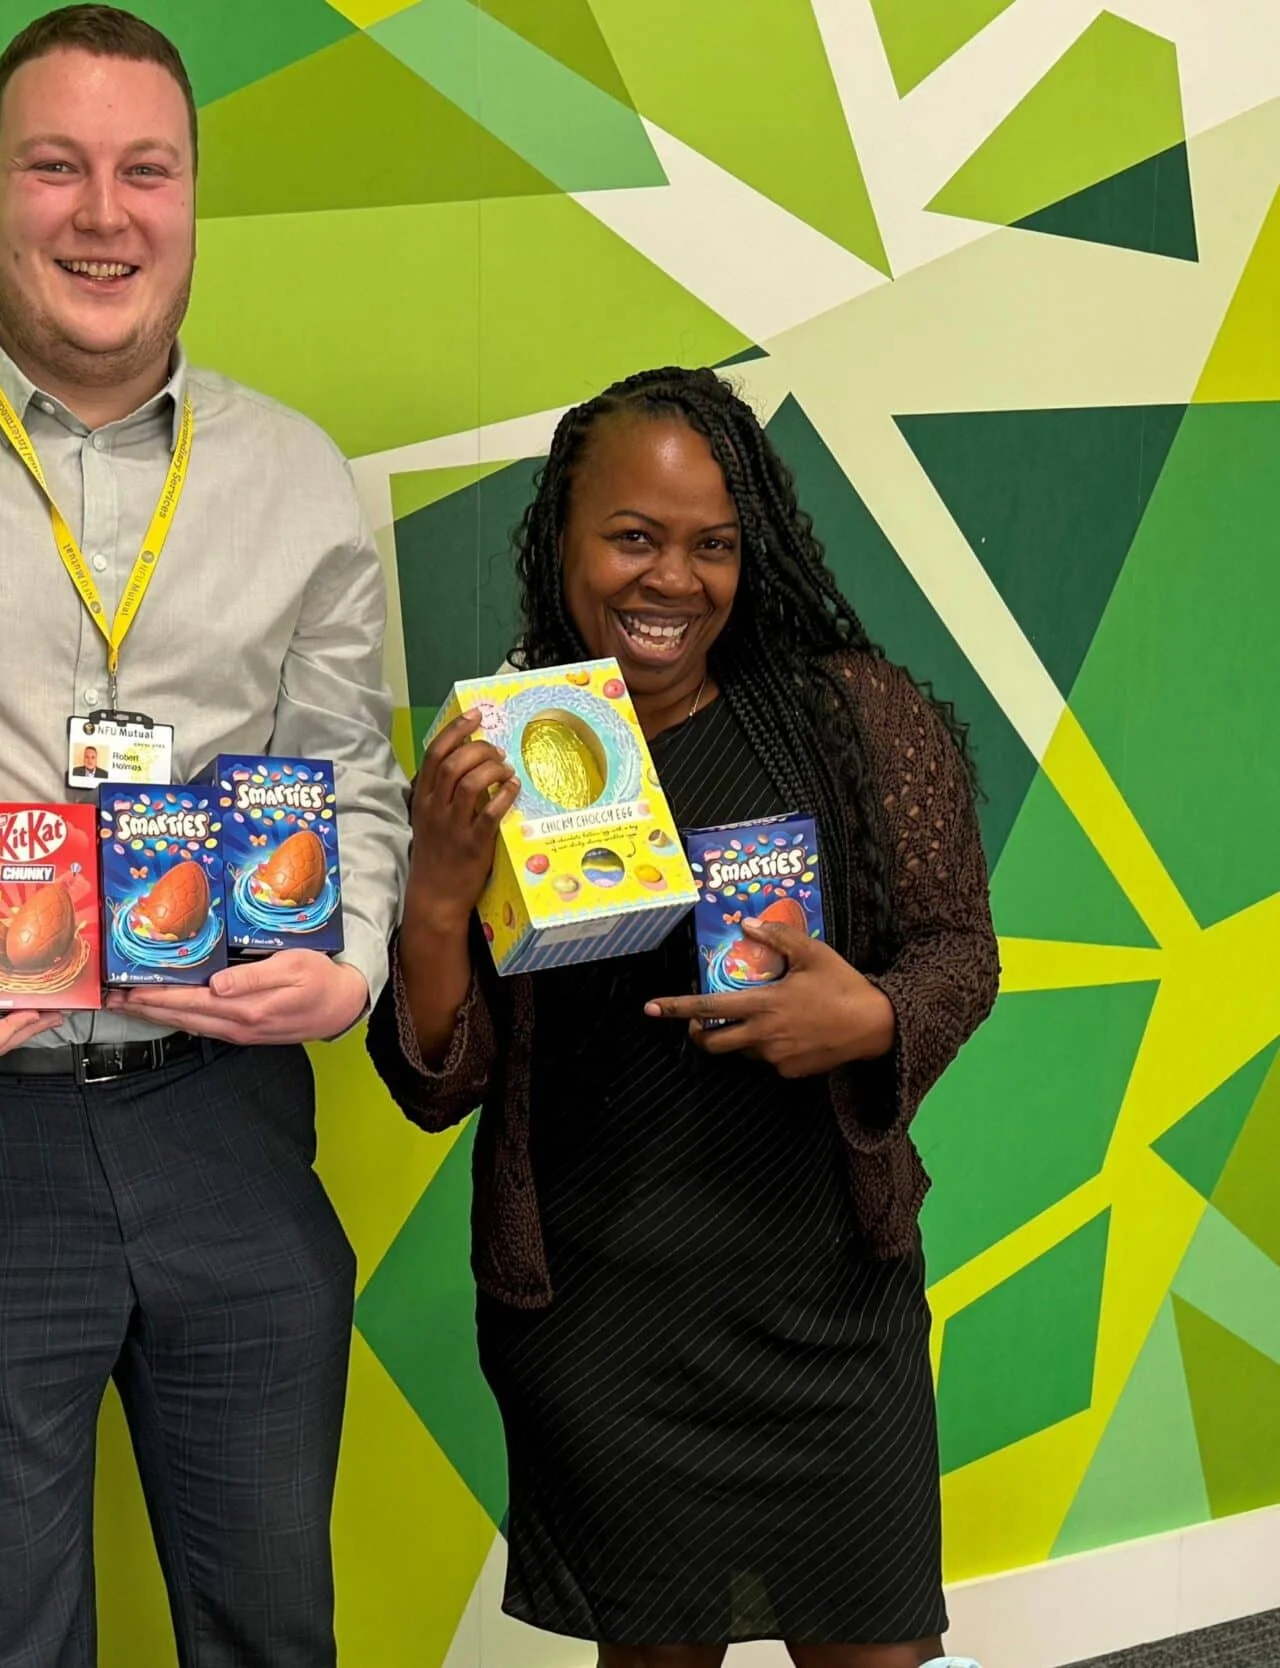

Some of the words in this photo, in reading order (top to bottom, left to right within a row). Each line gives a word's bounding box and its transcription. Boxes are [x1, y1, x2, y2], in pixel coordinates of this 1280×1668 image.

[159, 472, 182, 519] Services
[98, 726, 117, 736] NFU
[119, 728, 154, 739] Mutual
[112, 752, 139, 762] Robert
[112, 762, 142, 771] Holmes
[541, 817, 574, 834] CHICKY
[615, 806, 633, 820] EGG
[2, 867, 53, 881] CHUNKY
